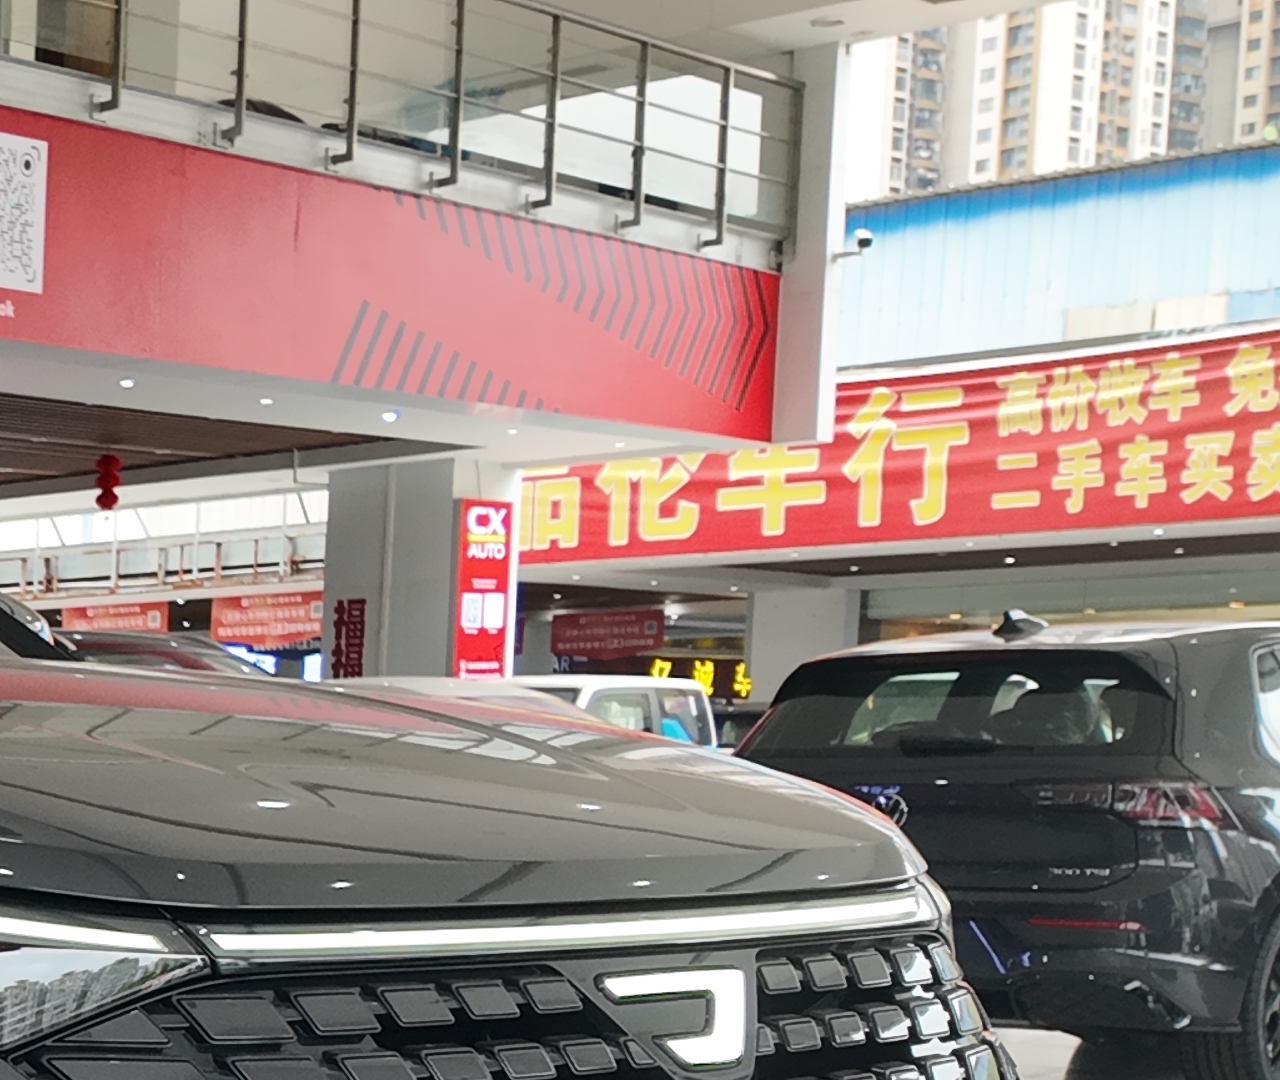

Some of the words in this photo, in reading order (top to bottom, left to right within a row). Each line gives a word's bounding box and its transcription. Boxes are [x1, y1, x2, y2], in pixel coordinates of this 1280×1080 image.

[995, 352, 1202, 437] 高价收车
[467, 506, 507, 535] CX
[467, 543, 506, 560] AUTO
